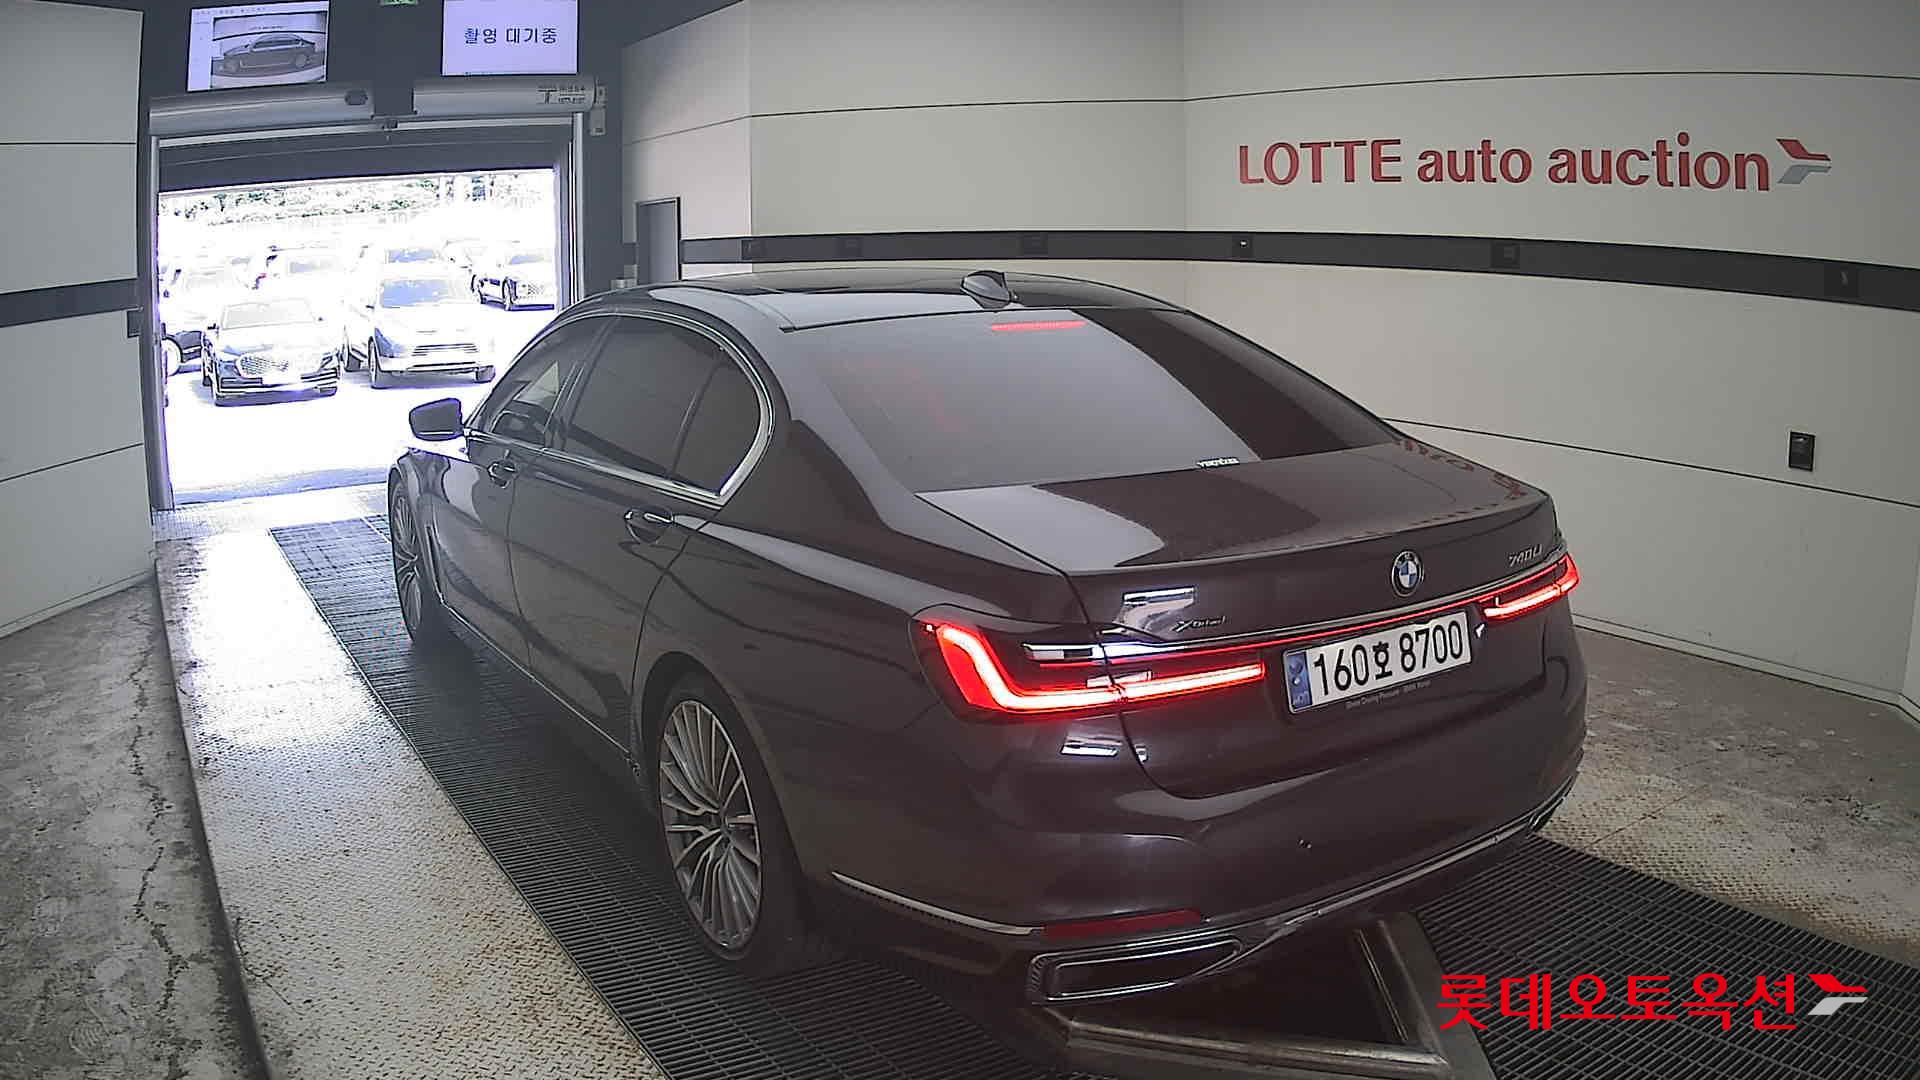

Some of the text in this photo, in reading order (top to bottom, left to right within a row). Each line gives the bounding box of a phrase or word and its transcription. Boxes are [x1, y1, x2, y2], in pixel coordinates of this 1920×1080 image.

[505, 27, 557, 45] 대기중
[1239, 132, 1770, 191] LOTTE auto auction
[1313, 640, 1393, 697] 160호
[1399, 619, 1464, 674] 8700
